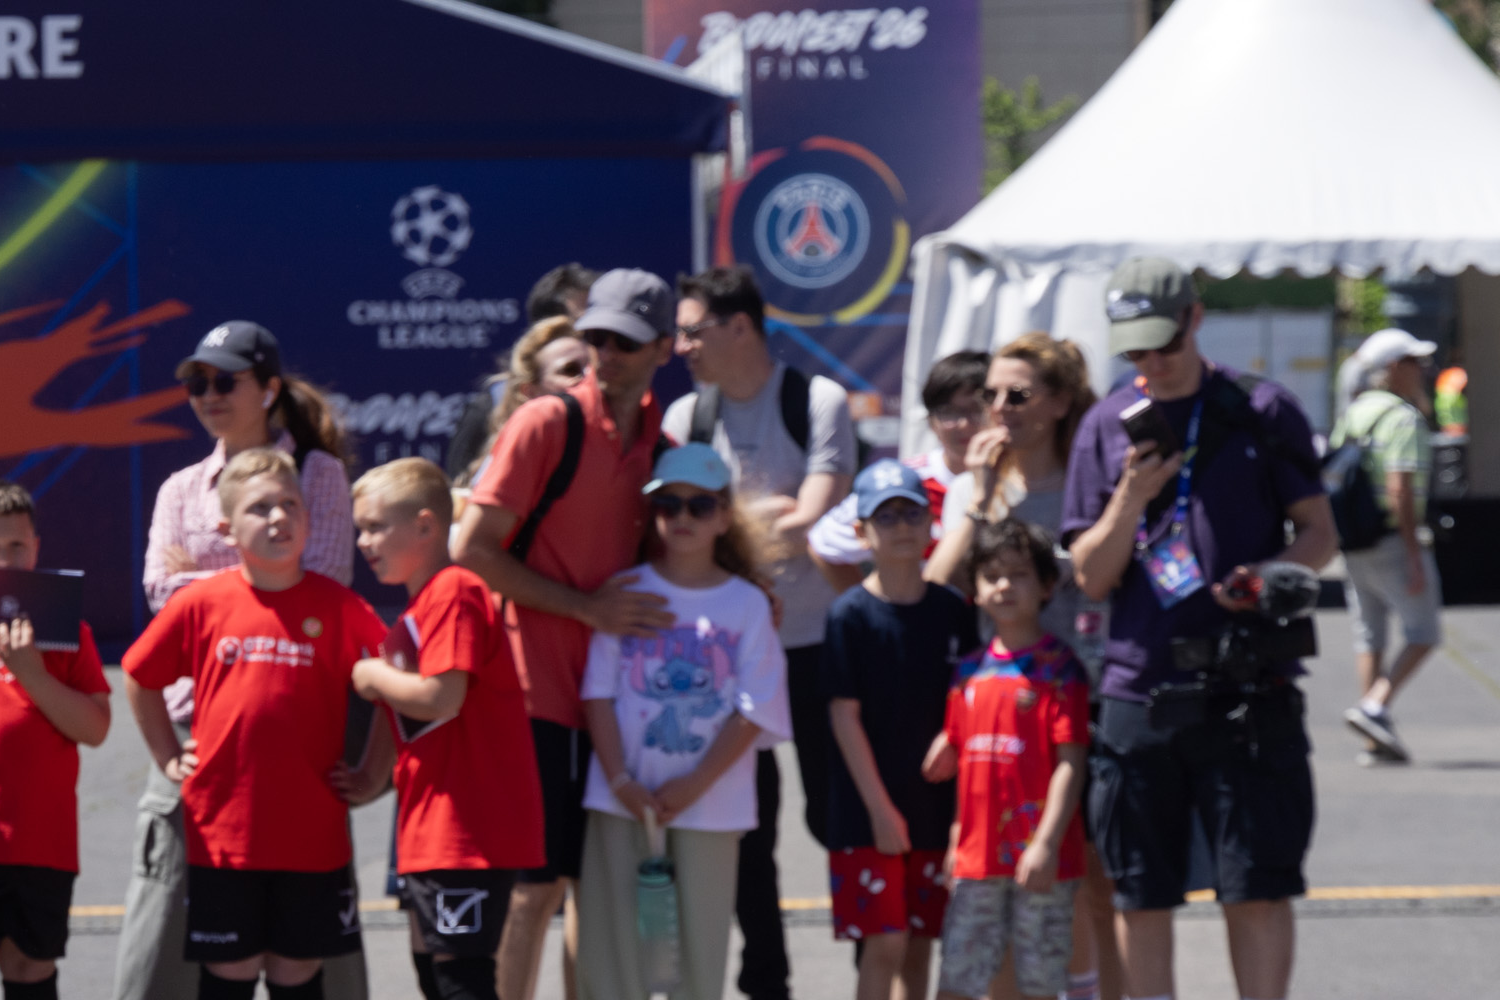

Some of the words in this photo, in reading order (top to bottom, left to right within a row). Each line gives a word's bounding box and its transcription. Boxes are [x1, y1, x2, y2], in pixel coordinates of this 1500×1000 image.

[756, 55, 870, 81] FINAL
[347, 299, 519, 325] CHAMPIONS
[377, 323, 489, 349] LEAGUE
[243, 636, 276, 653] OTP
